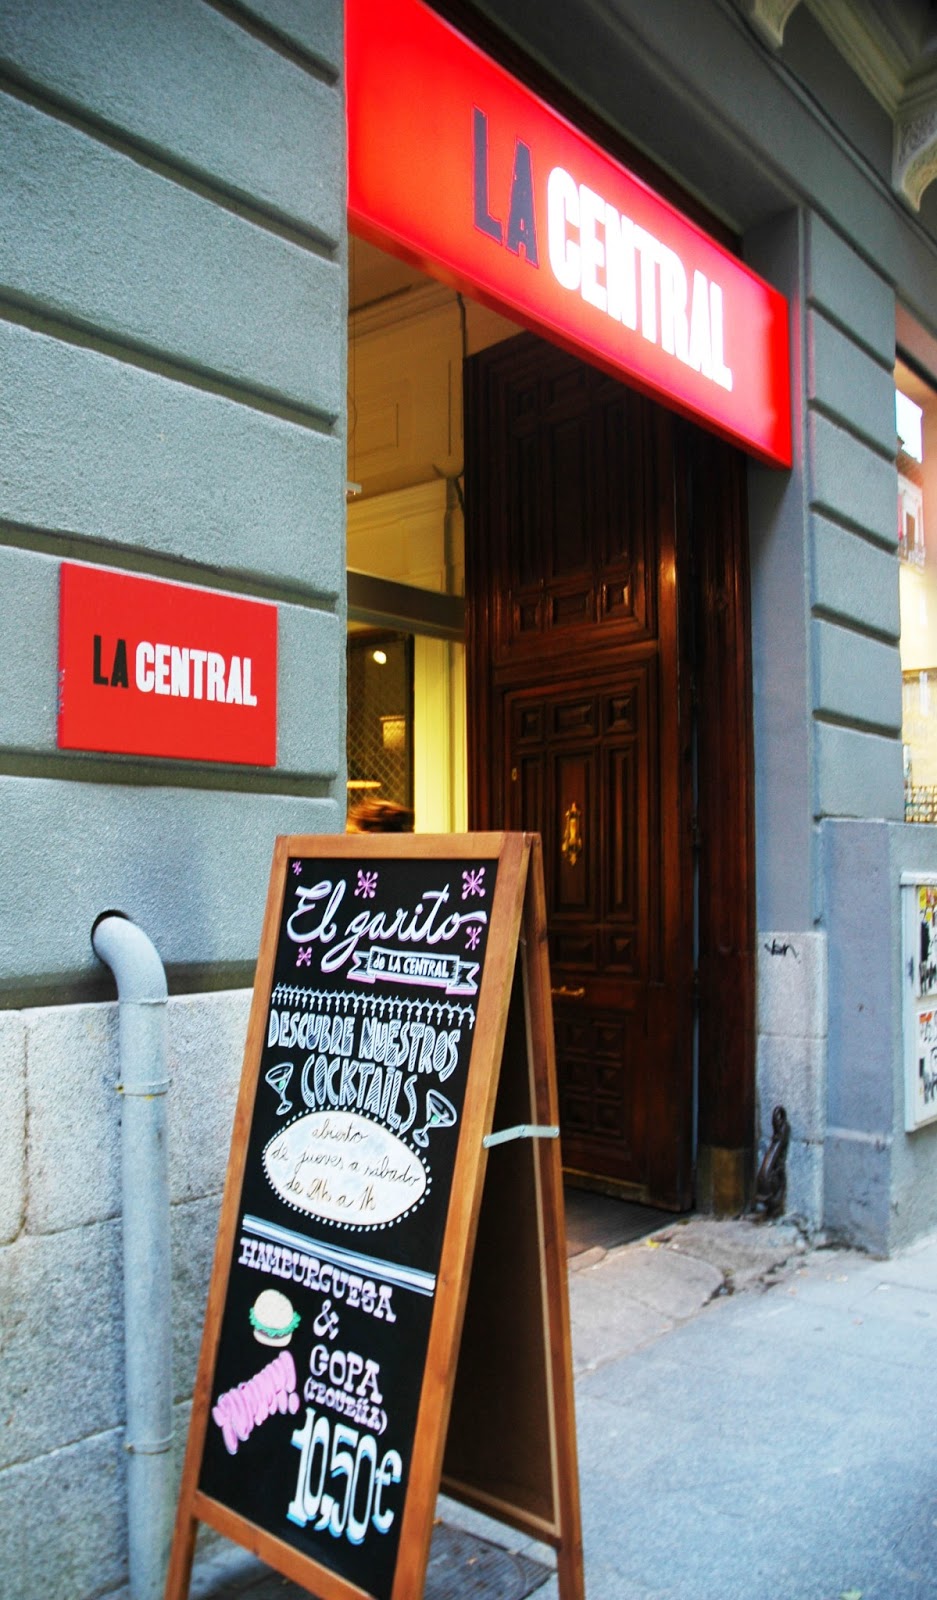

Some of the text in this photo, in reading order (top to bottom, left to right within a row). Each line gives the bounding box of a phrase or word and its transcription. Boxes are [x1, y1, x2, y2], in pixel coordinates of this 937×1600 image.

[472, 103, 733, 392] LA CENTRAL
[93, 634, 257, 706] LA CENTRAL
[287, 879, 487, 973] El garito
[388, 955, 401, 973] LA
[403, 957, 449, 978] CENTRAL
[267, 1009, 461, 1083] DESCUBRE NUESTROS
[271, 1141, 288, 1161] de
[349, 1162, 359, 1172] a
[312, 1119, 368, 1143] abierto
[283, 1174, 303, 1195] de
[337, 1195, 354, 1208] a
[238, 1237, 396, 1323] HAMBURGUESA
[313, 1299, 340, 1340] &
